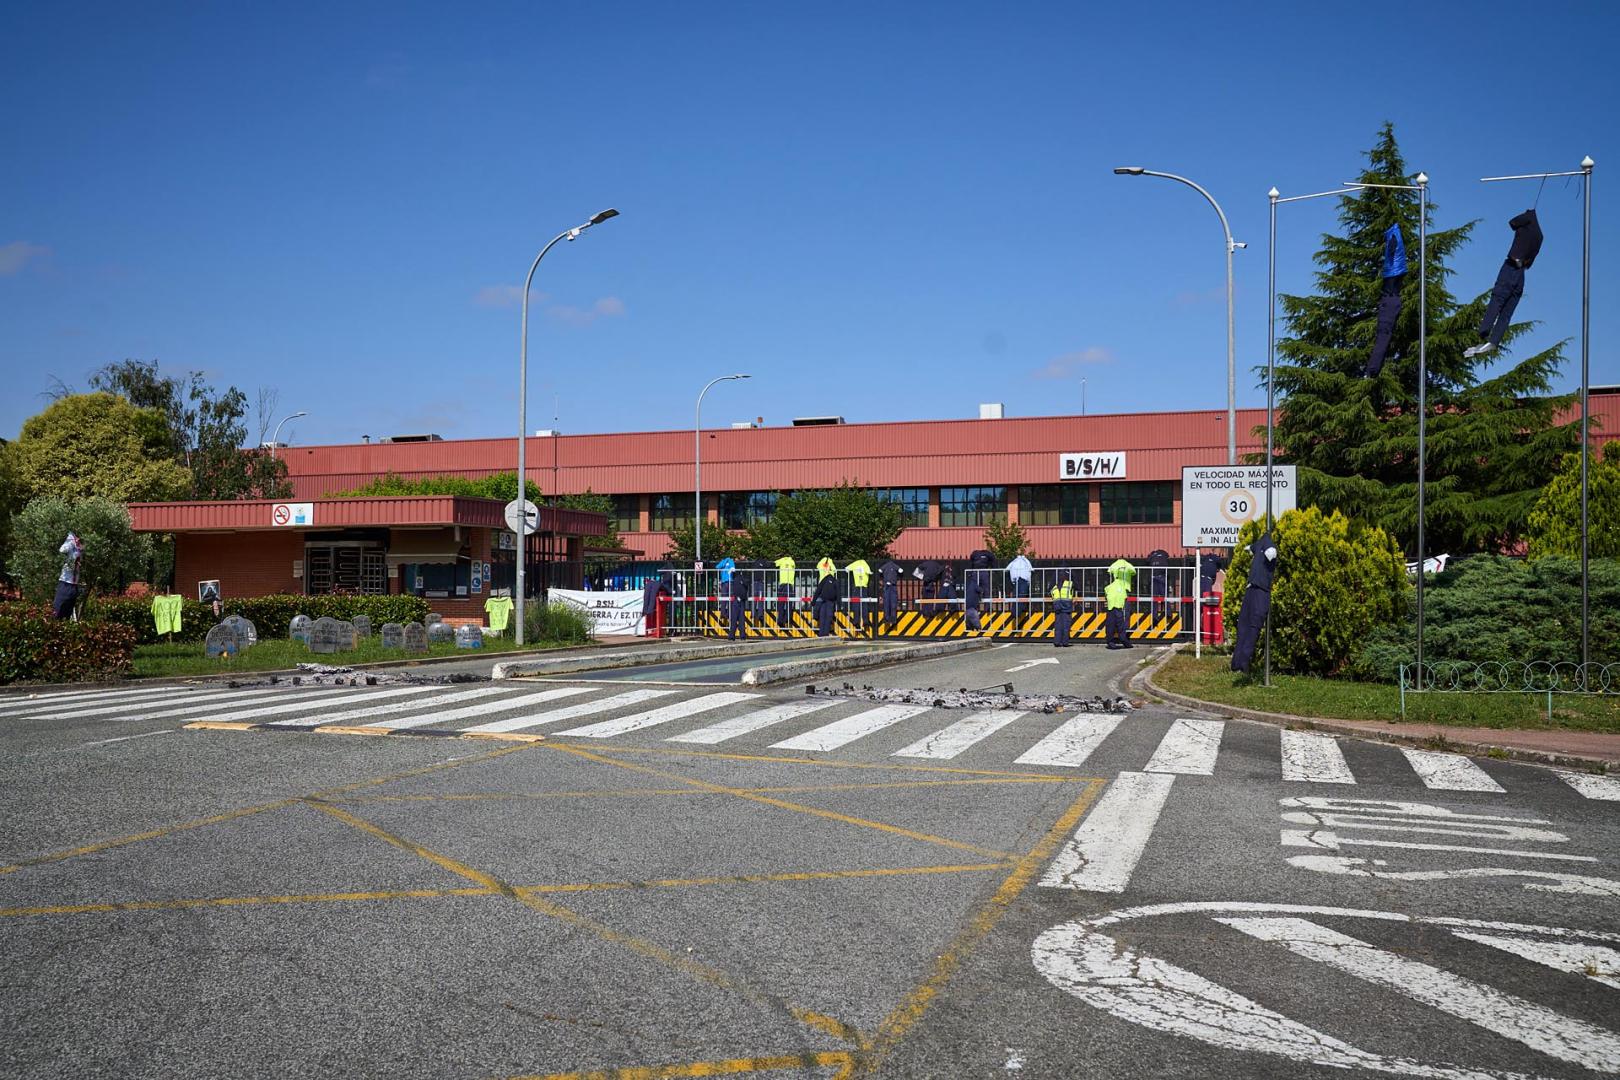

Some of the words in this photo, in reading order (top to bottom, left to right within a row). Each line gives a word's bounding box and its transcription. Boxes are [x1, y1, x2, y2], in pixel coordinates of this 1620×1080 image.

[1066, 457, 1119, 476] B/S/H/
[1194, 471, 1245, 479] VELOCIDAD
[1248, 469, 1284, 478] MÁXMA
[1206, 481, 1231, 489] TODO
[1234, 481, 1246, 489] EL
[1248, 480, 1288, 488] RECNTO
[1230, 500, 1248, 513] 30
[596, 600, 614, 608] BSH
[1279, 796, 1620, 898] STOP
